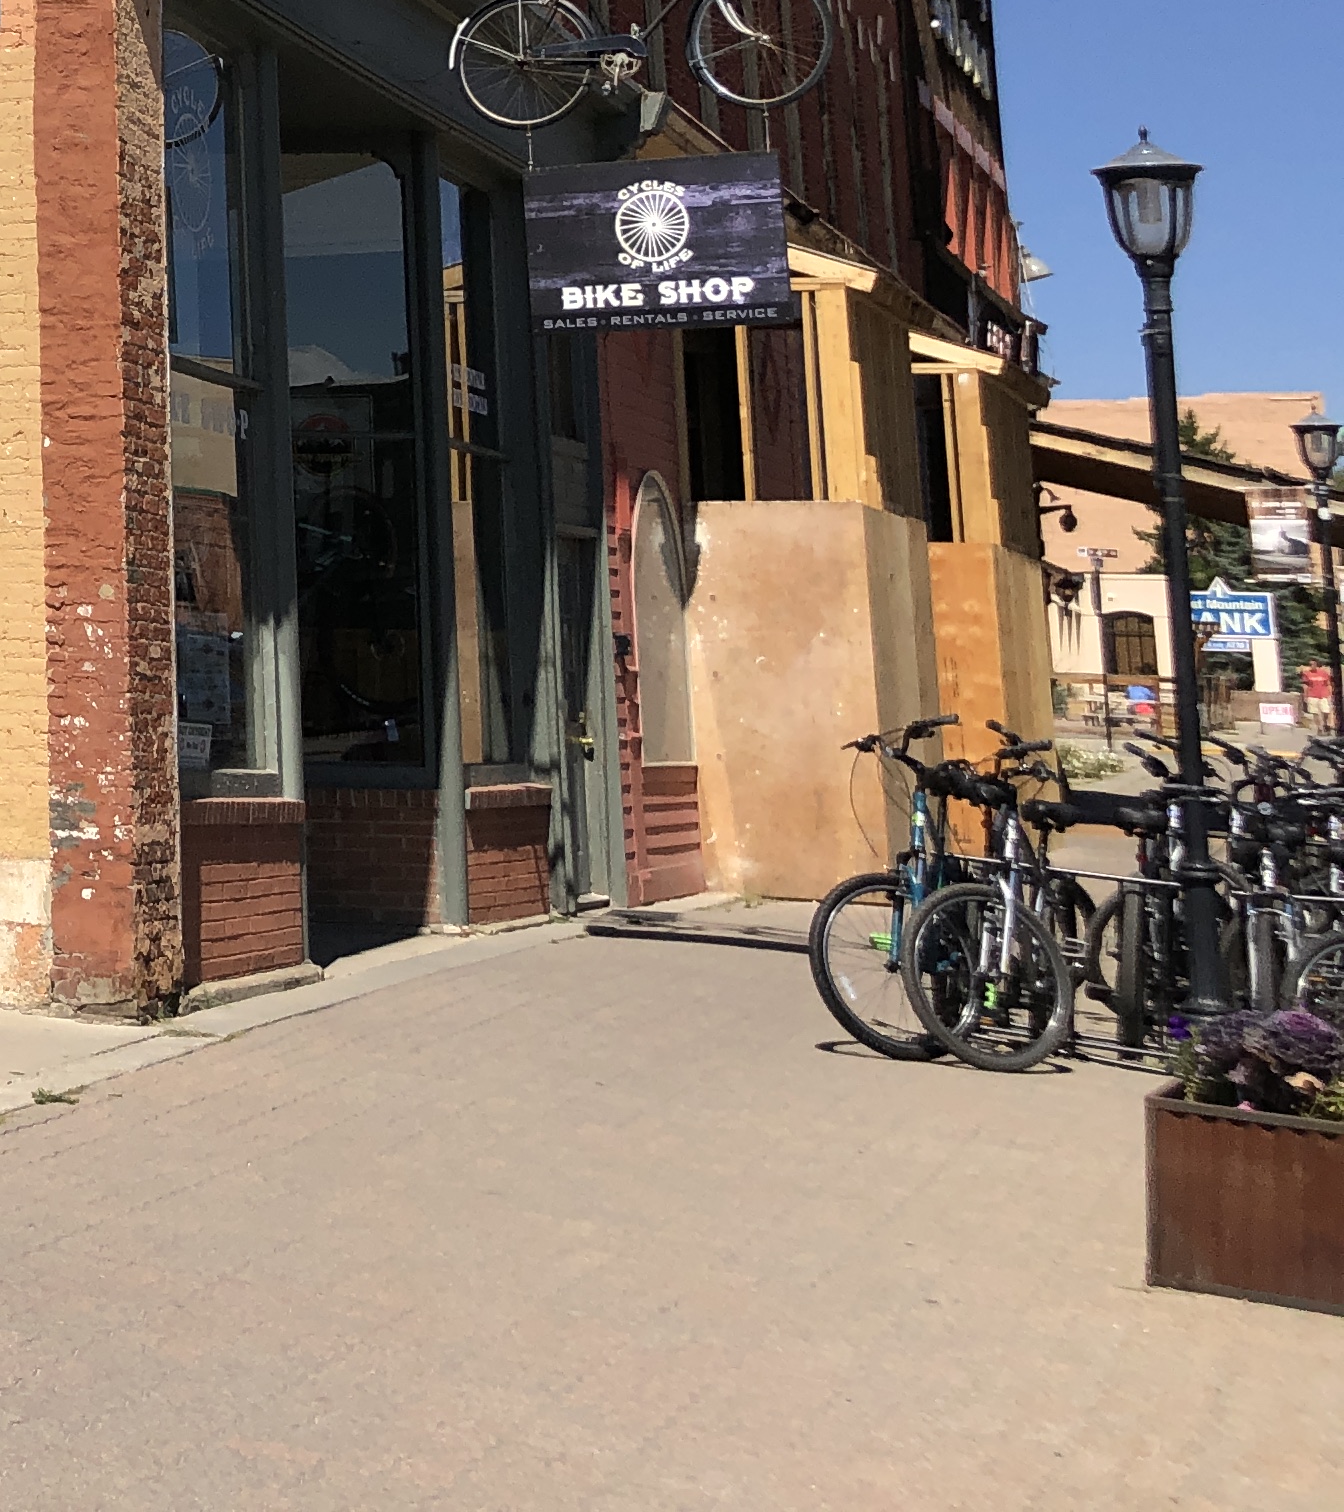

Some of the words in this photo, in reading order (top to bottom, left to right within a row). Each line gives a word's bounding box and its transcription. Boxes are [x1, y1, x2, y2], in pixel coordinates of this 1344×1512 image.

[617, 180, 686, 200] CYCLES
[617, 252, 644, 269] OF
[652, 248, 695, 273] LIFE
[561, 283, 645, 310] BIKE
[658, 276, 755, 305] SHOP
[543, 317, 598, 329] SALES
[610, 312, 688, 326] RENTALS
[702, 307, 778, 321] SERVICE
[1191, 611, 1268, 634] ANK
